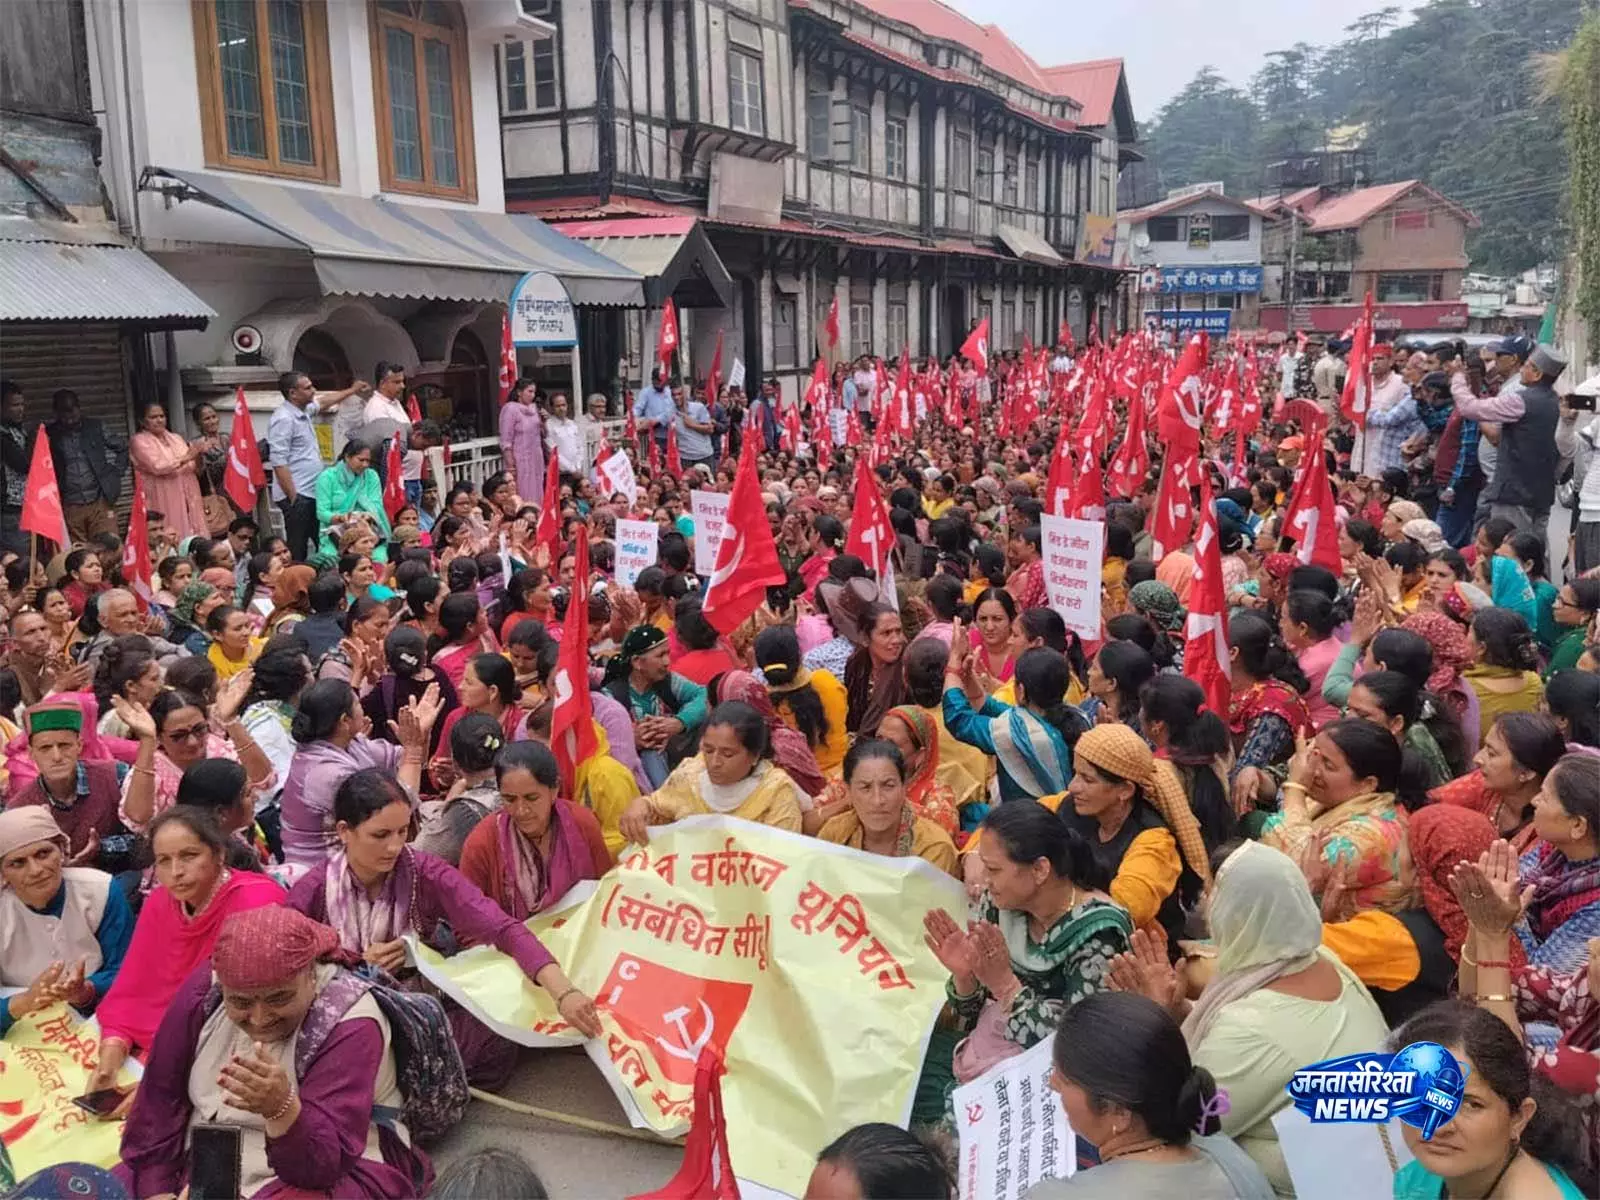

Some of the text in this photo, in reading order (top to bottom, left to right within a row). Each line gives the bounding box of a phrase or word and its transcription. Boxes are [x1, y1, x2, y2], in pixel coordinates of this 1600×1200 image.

[1195, 317, 1226, 327] BANK
[691, 837, 790, 892] वर्करज
[790, 880, 916, 992] यूनियन
[994, 1078, 1010, 1109] लेना
[1020, 1076, 1032, 1104] अपने
[1000, 1107, 1014, 1126] बंद
[998, 1125, 1013, 1148] करो
[997, 1148, 1009, 1164] या
[1017, 1143, 1029, 1182] अलावा
[995, 1163, 1012, 1195] उचित
